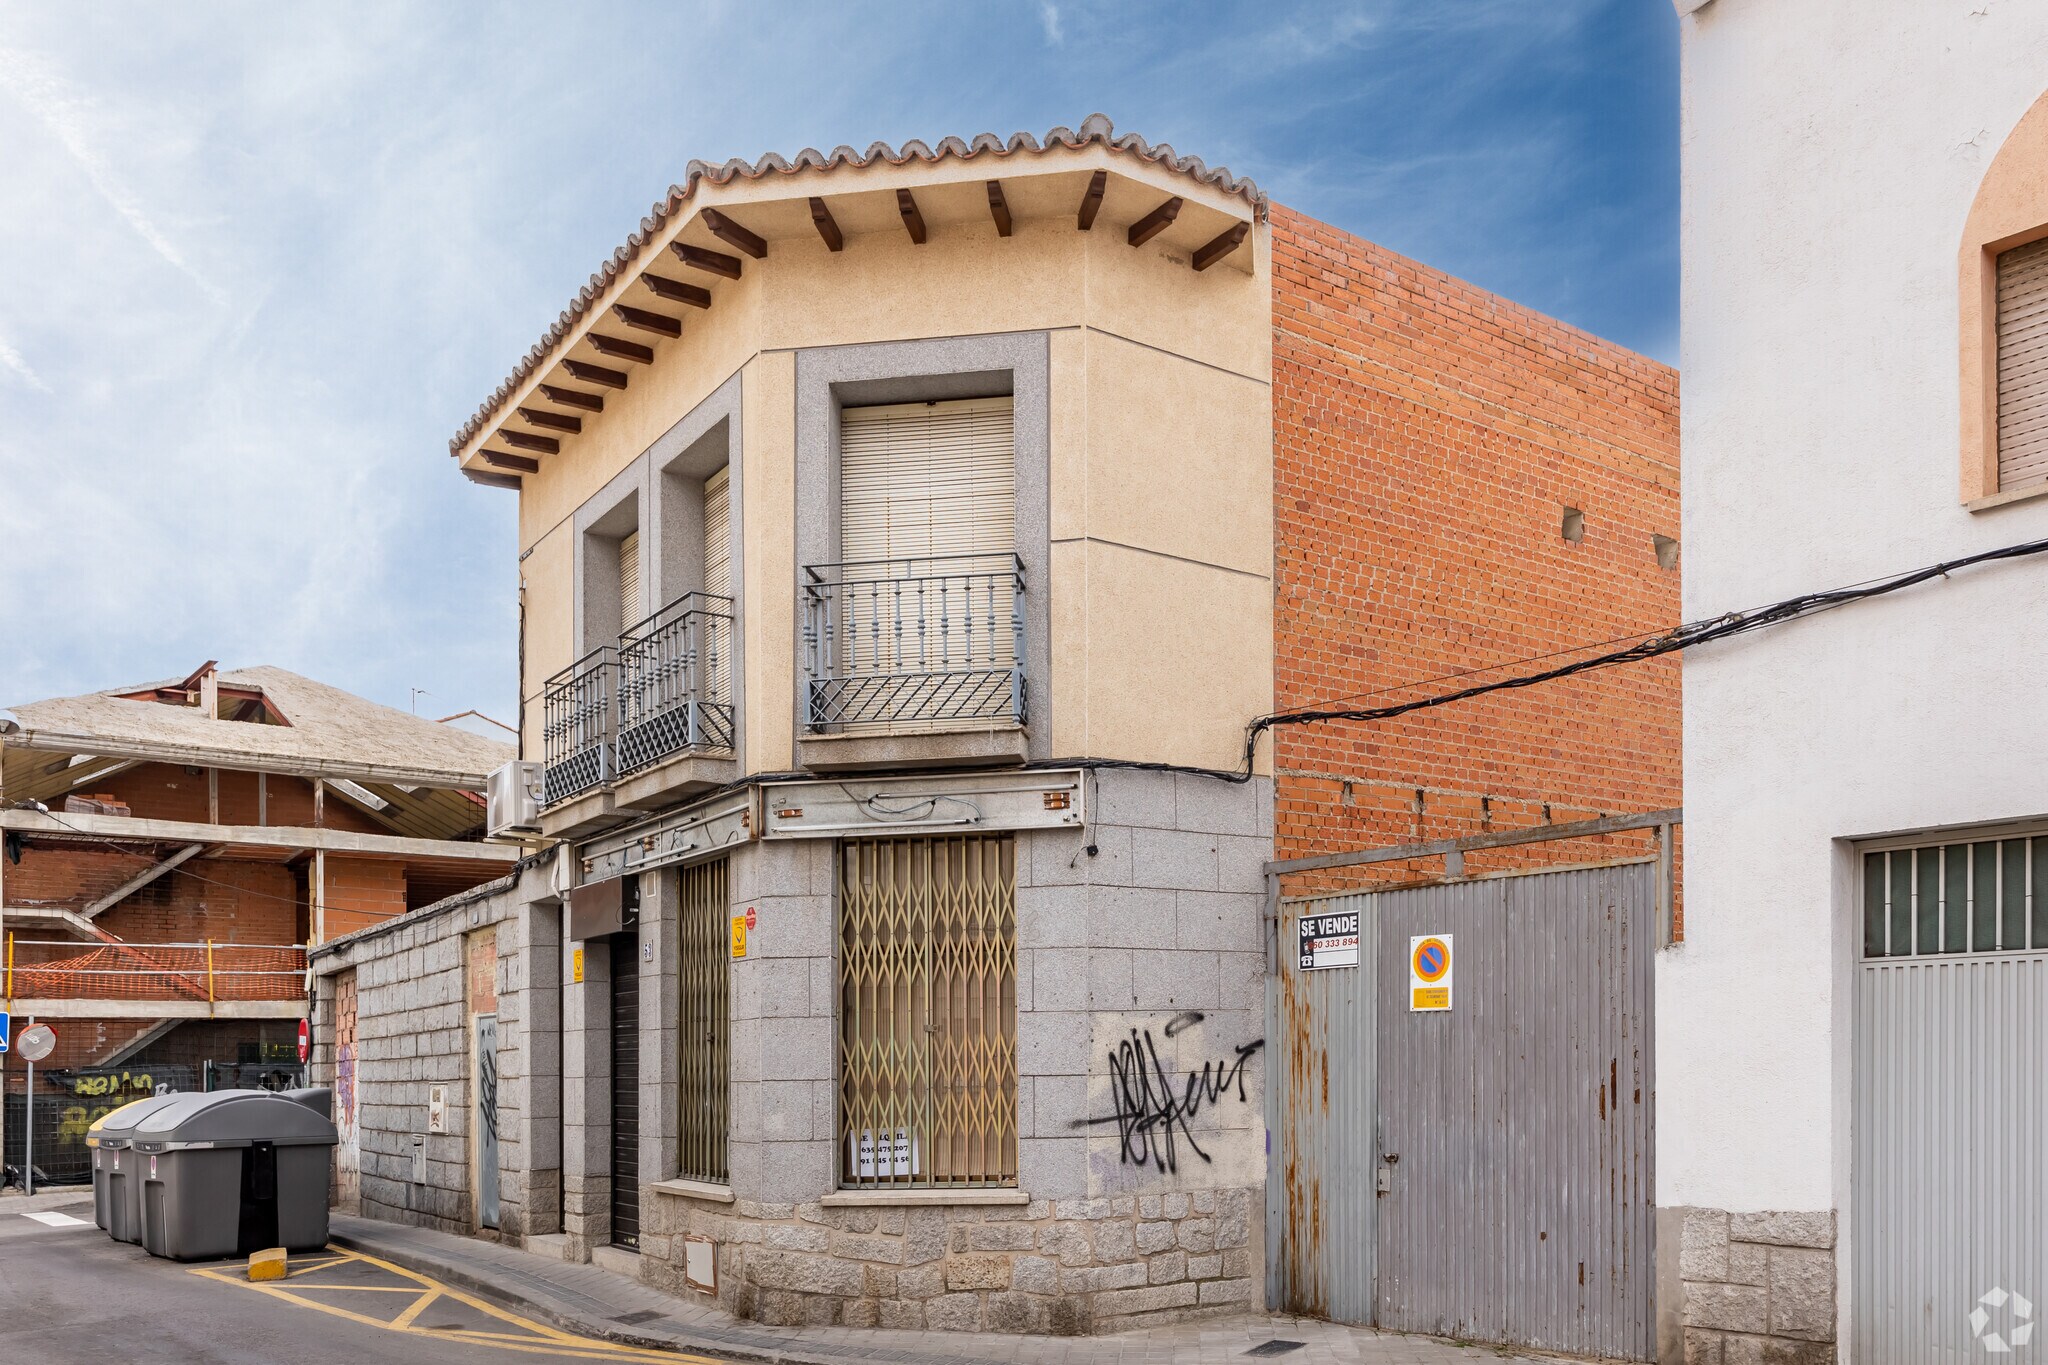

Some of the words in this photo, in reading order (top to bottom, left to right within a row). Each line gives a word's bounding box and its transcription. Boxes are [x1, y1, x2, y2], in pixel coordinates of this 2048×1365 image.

[1301, 920, 1315, 937] SE
[1317, 915, 1358, 935] VENDE
[1325, 938, 1340, 948] 333
[1342, 936, 1359, 947] 894
